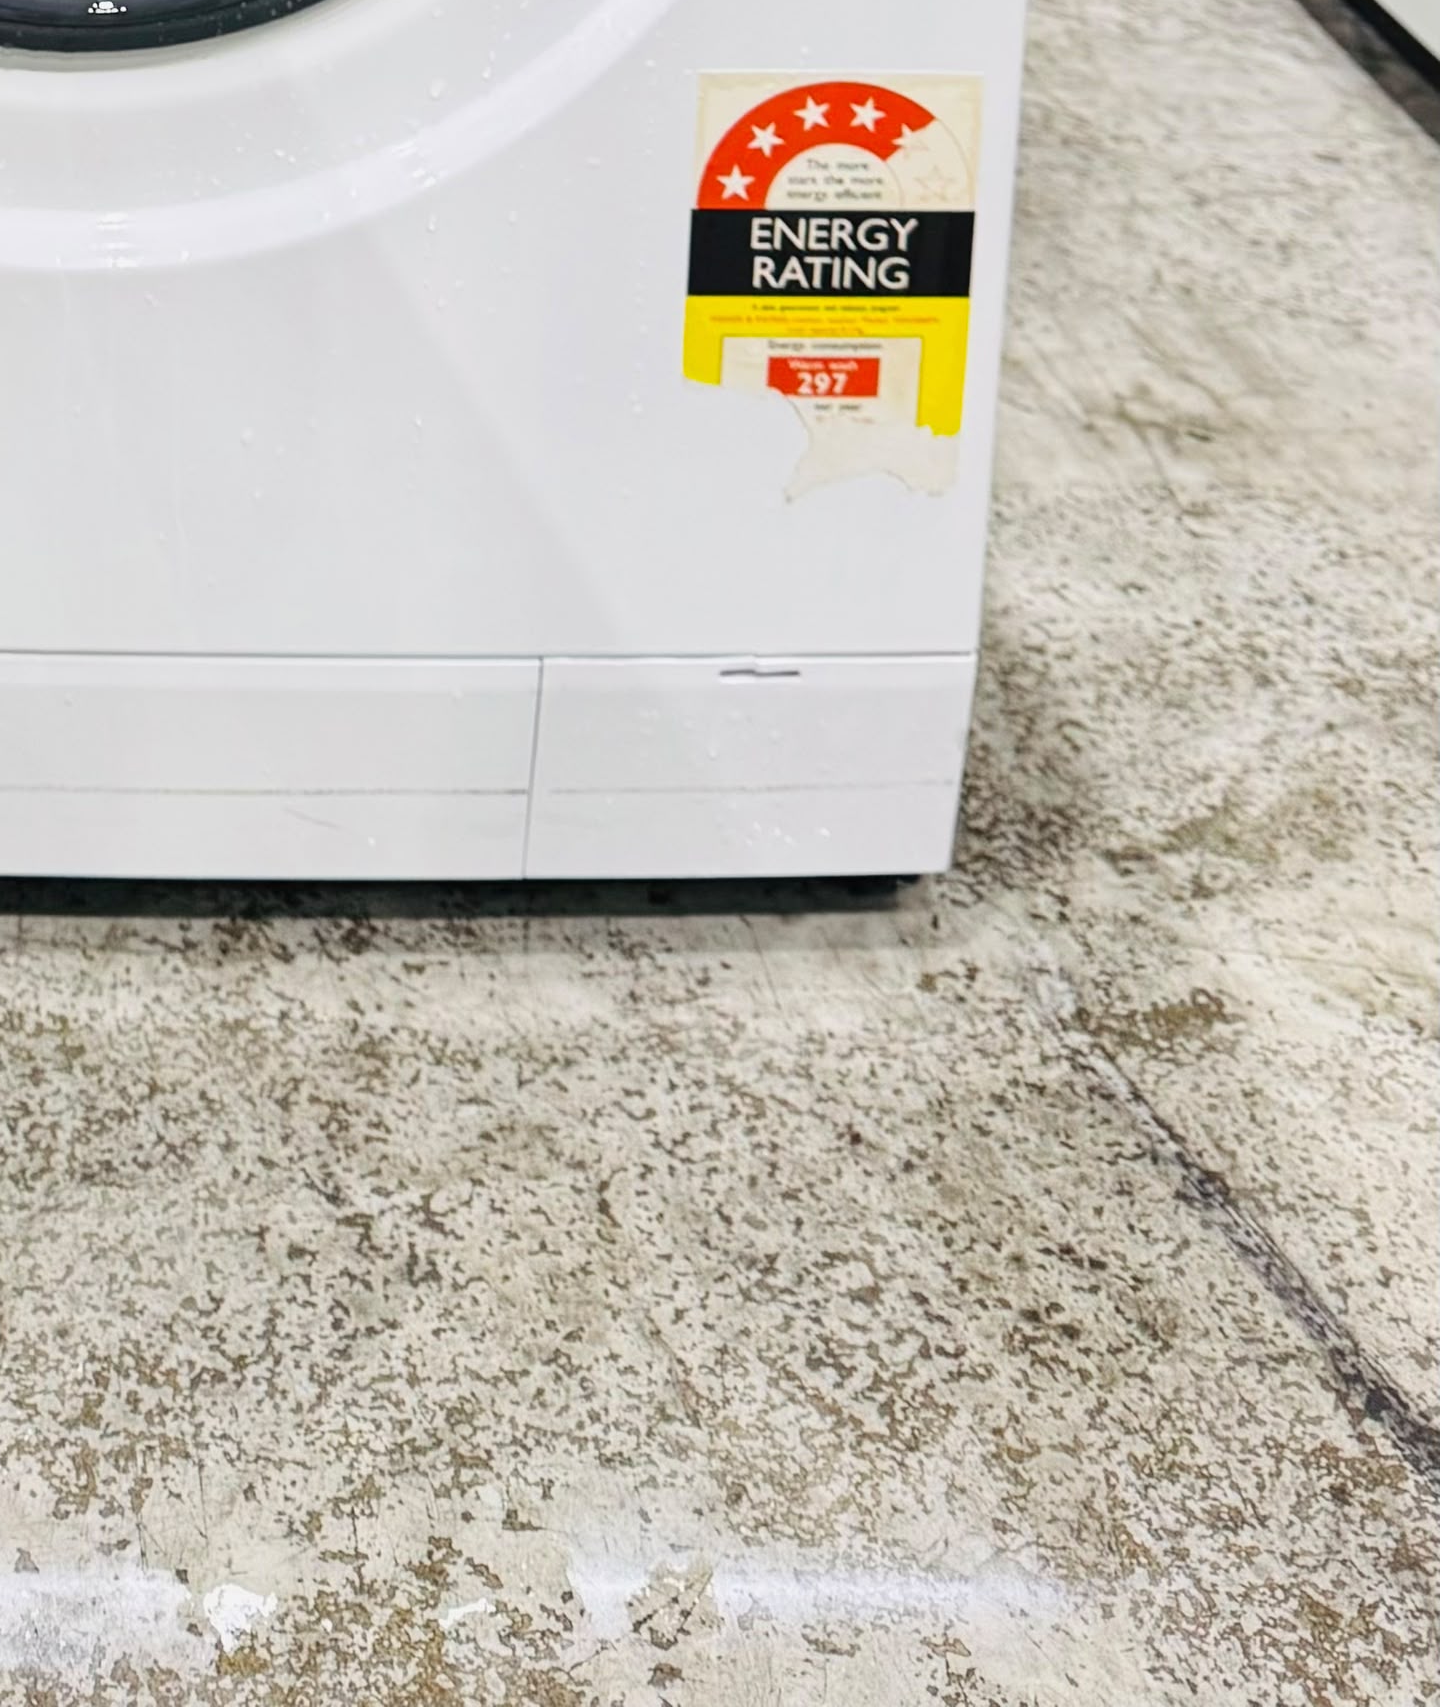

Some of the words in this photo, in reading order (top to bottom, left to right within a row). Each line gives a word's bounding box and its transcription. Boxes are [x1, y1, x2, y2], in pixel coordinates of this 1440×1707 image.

[750, 217, 919, 251] ENERGY
[752, 255, 910, 290] RATING
[787, 359, 824, 370] Warm
[829, 360, 858, 371] wash
[797, 373, 848, 395] 297
